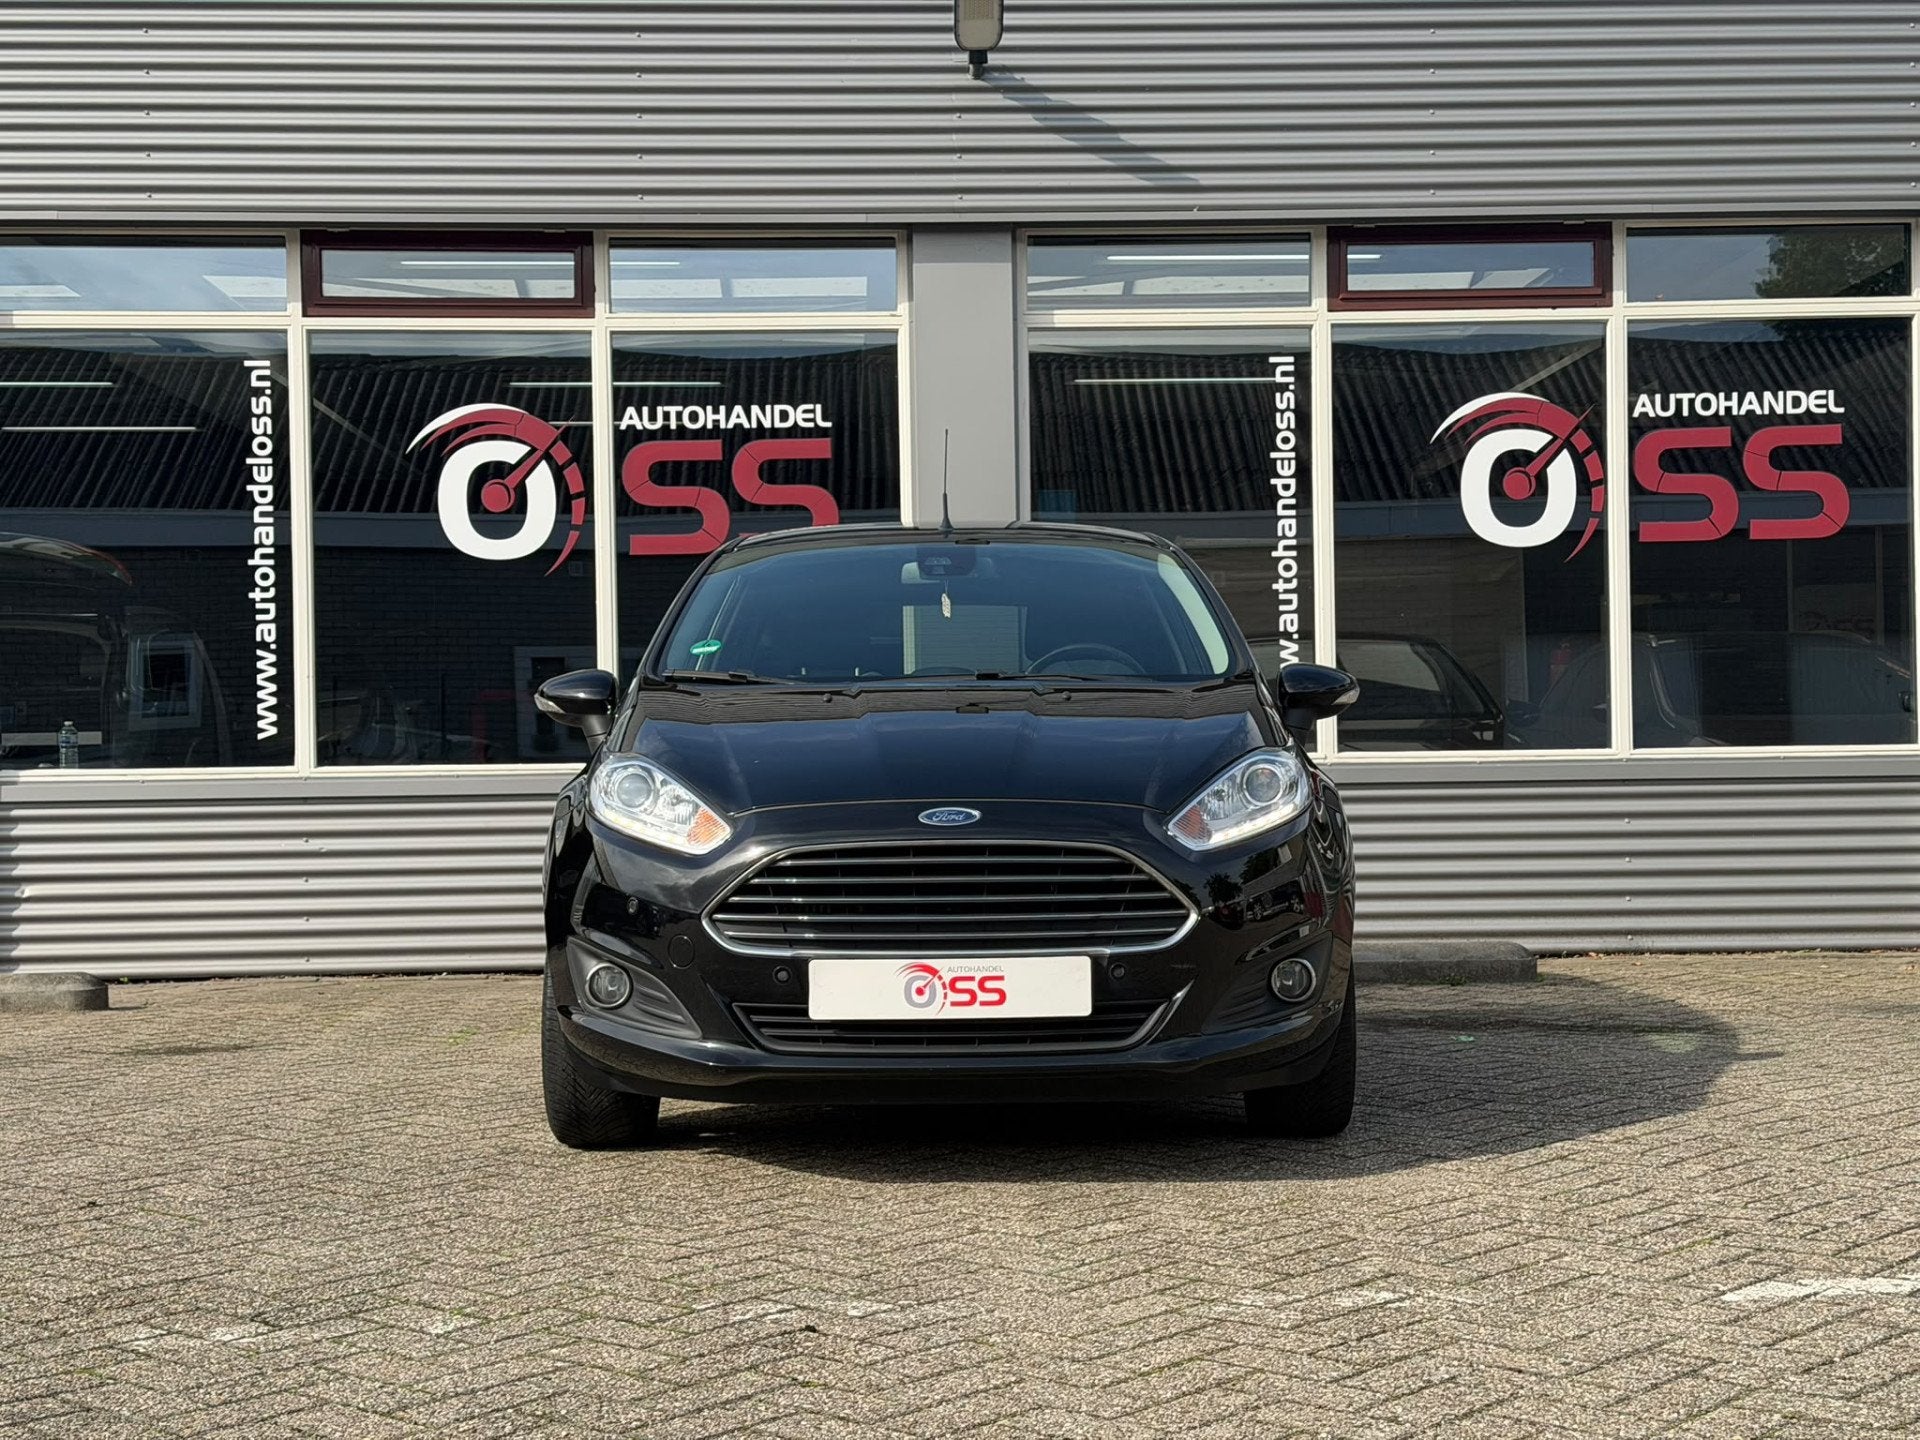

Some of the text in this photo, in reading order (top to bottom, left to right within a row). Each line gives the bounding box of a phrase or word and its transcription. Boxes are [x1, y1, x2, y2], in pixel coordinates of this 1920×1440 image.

[619, 403, 833, 430] AUTOHANDEL
[1632, 389, 1845, 418] AUTOHANDEL
[437, 439, 840, 560] OSS
[1460, 424, 1850, 548] OSS
[1269, 356, 1300, 669] w.autohandeloss.nl
[243, 359, 278, 740] www.autohandeloss.nl
[932, 810, 966, 821] Ford
[947, 965, 1004, 973] AUTOHANDEL
[903, 975, 1007, 1009] OSS
